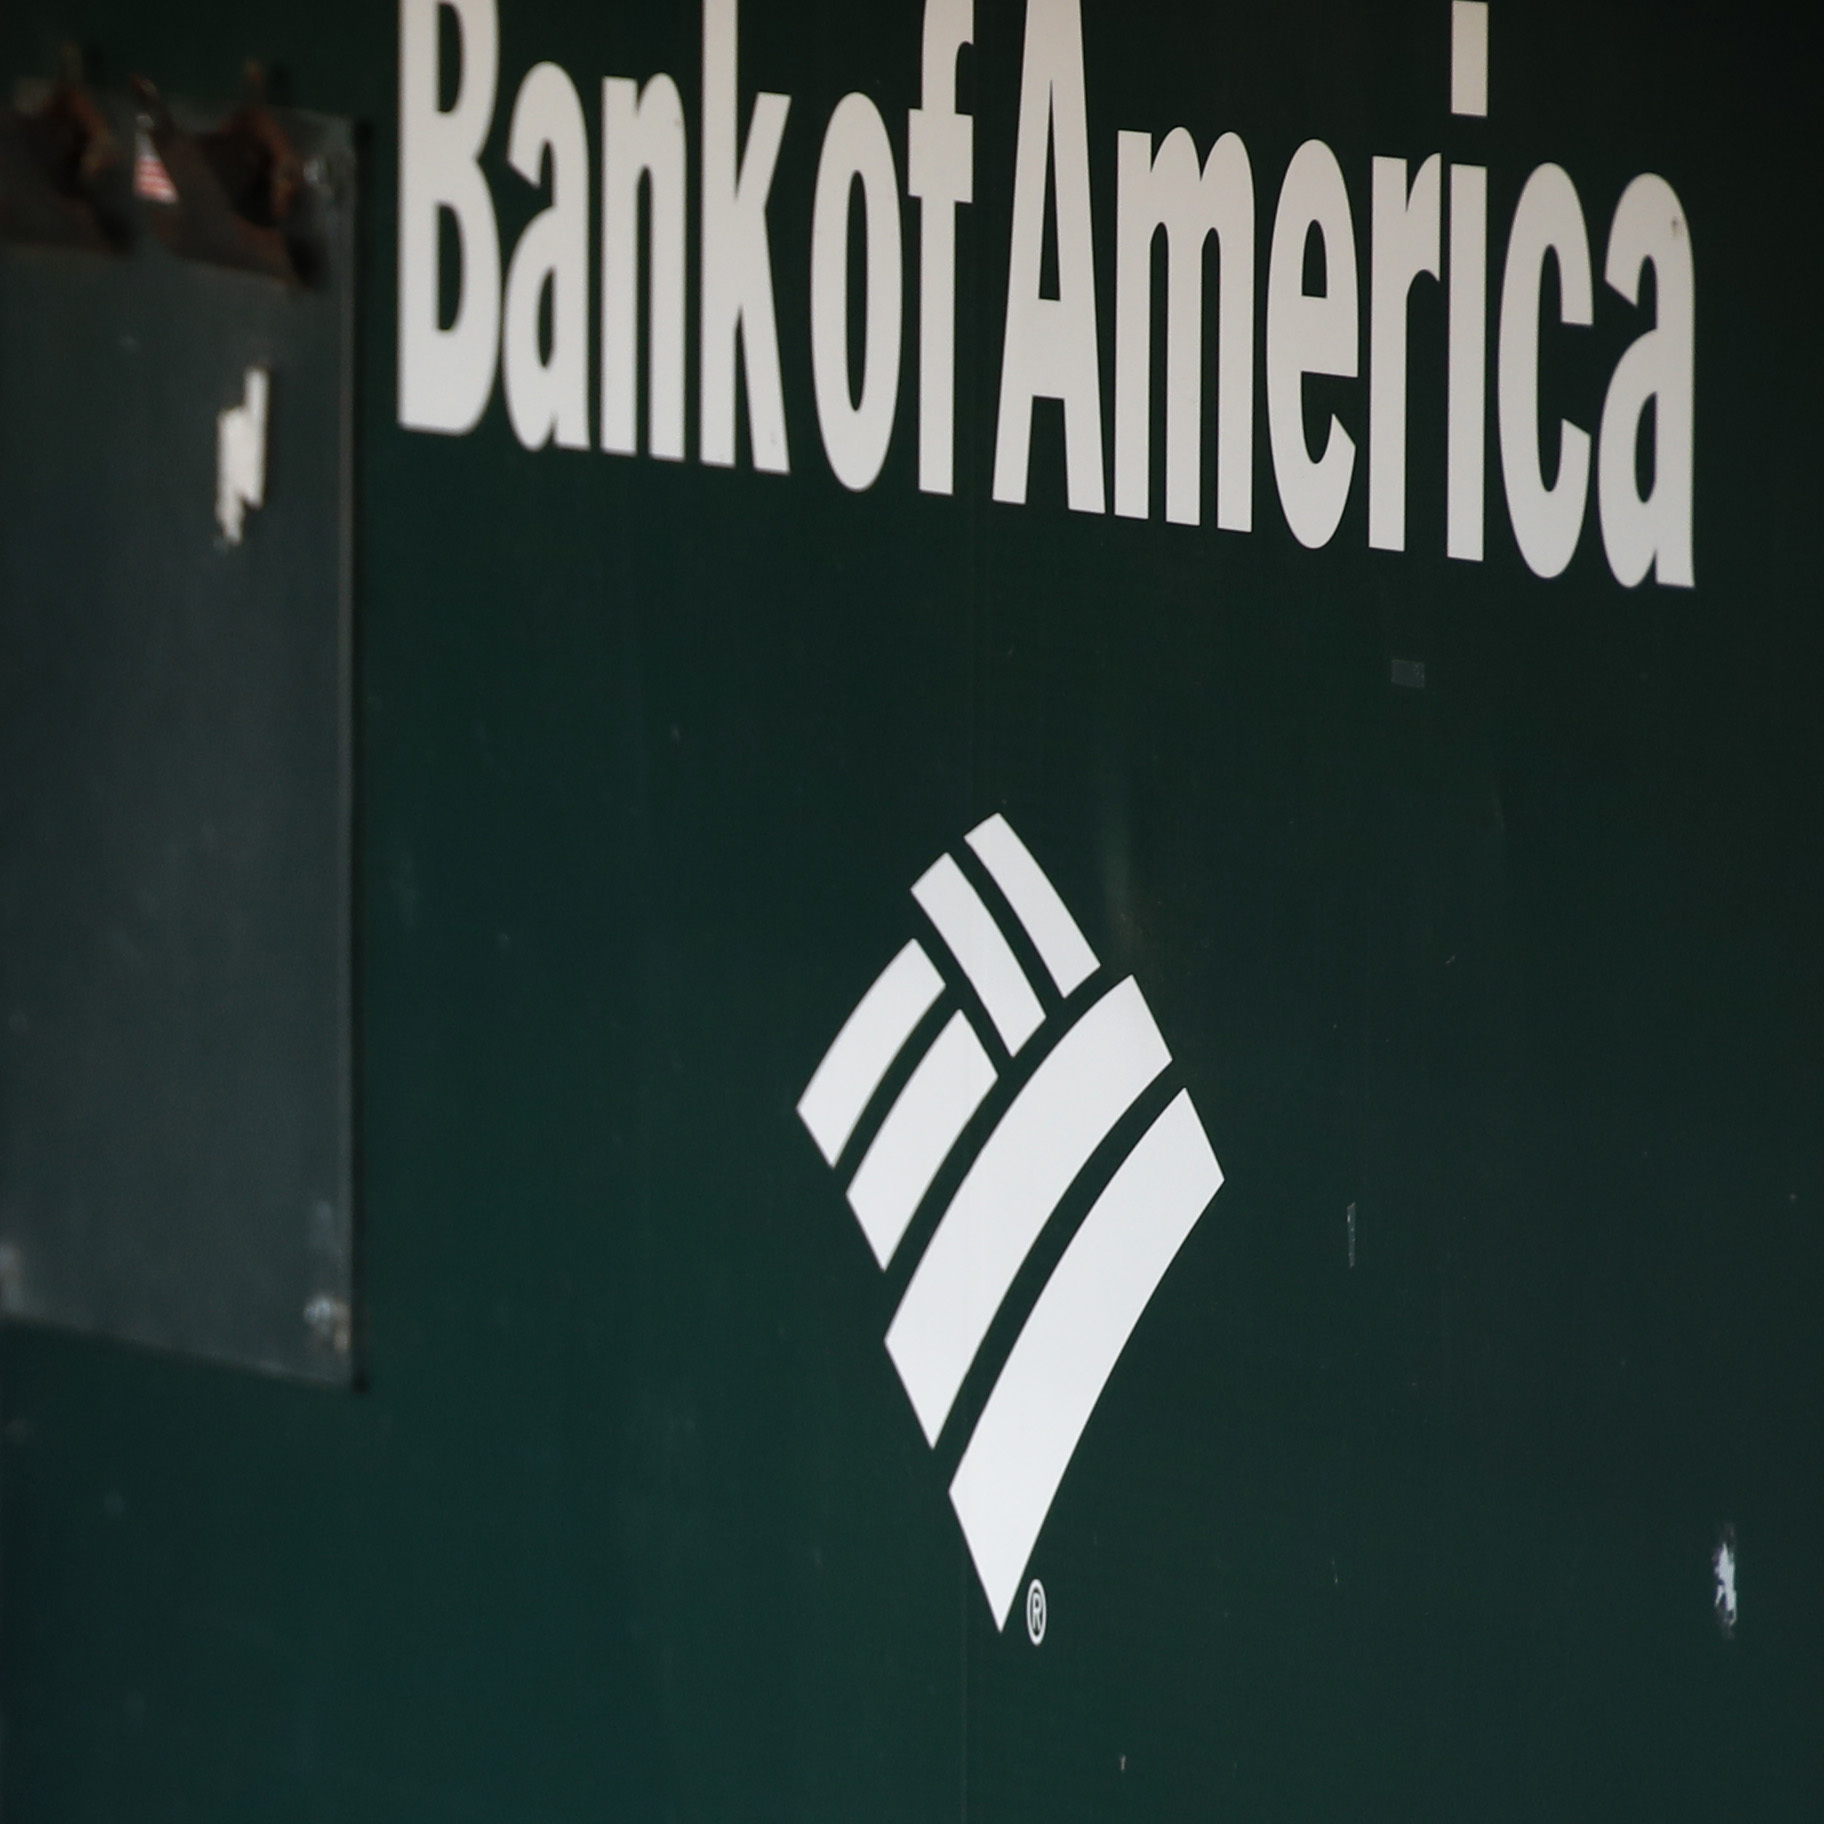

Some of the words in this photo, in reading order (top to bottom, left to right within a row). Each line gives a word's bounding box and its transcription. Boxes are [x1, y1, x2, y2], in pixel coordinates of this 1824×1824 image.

[398, 0, 791, 474] Bank
[810, 0, 974, 495] of
[992, 0, 1695, 589] America
